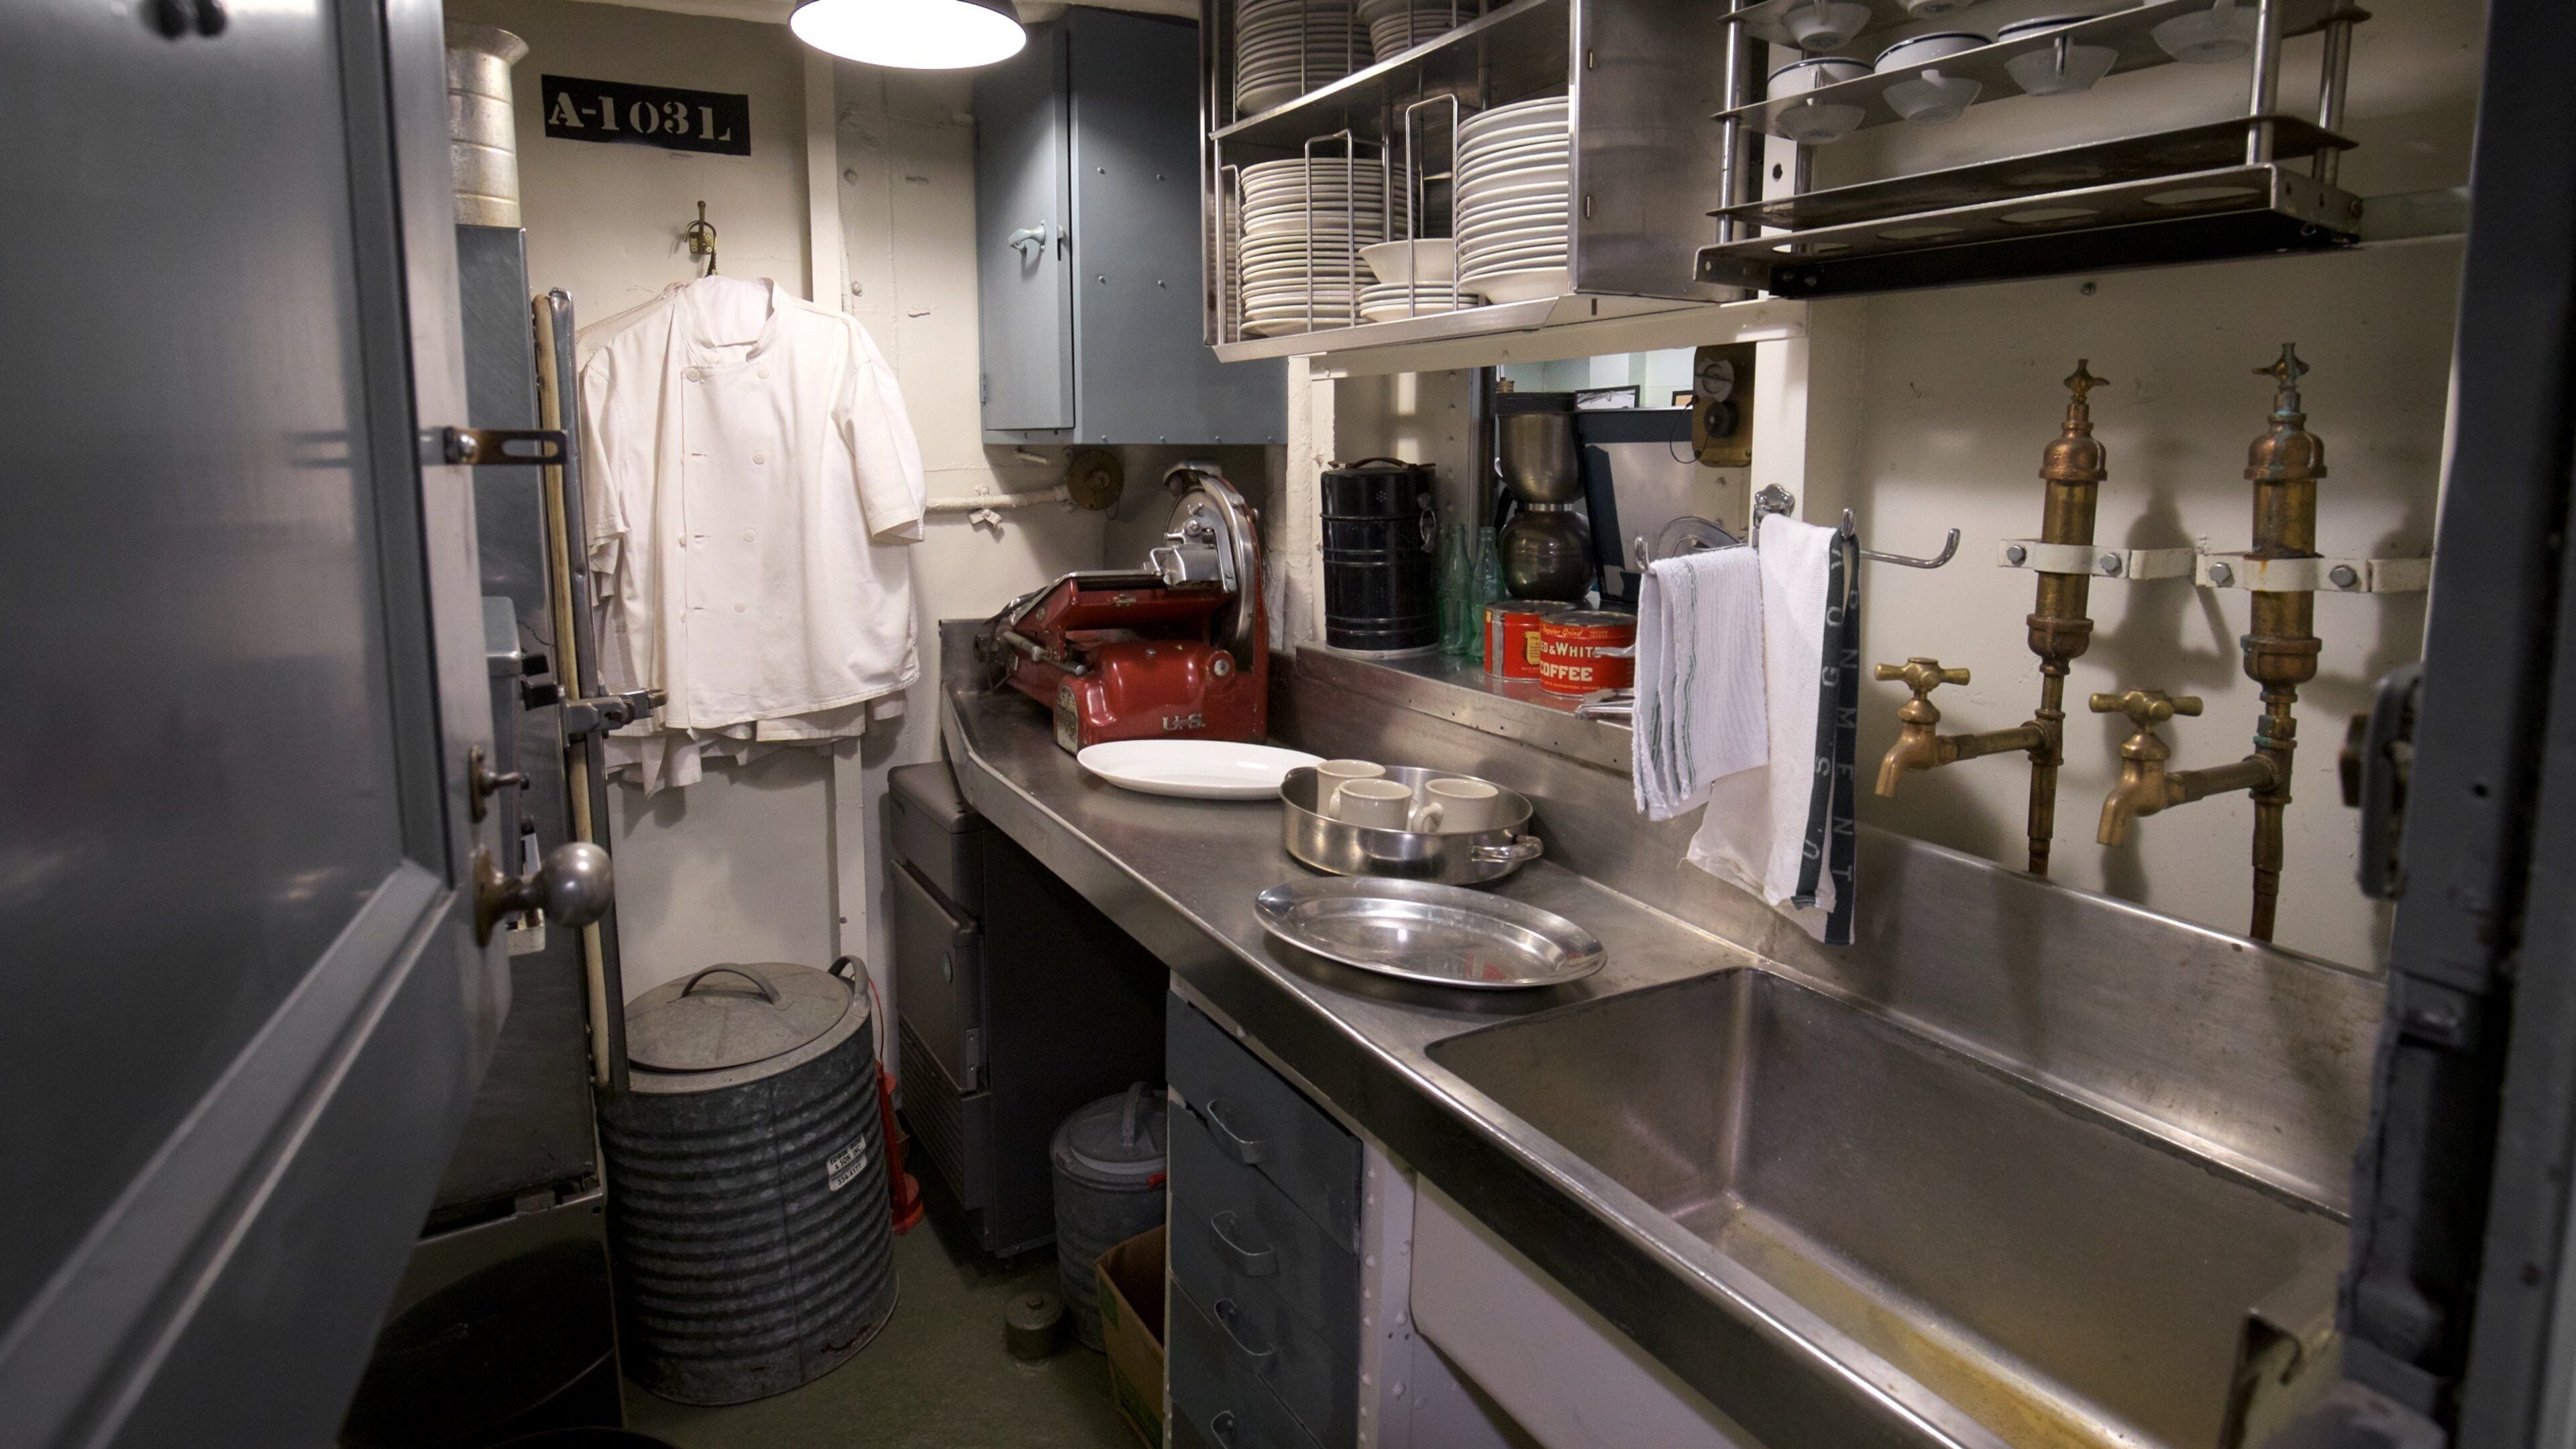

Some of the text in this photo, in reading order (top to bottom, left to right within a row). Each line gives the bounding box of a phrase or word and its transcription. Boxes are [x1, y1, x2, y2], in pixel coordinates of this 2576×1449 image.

[1562, 629, 1583, 638] Grind
[1540, 641, 1548, 653] ED
[1549, 645, 1556, 655] &
[1540, 660, 1594, 682] COFFEE
[839, 1154, 851, 1167] SON
